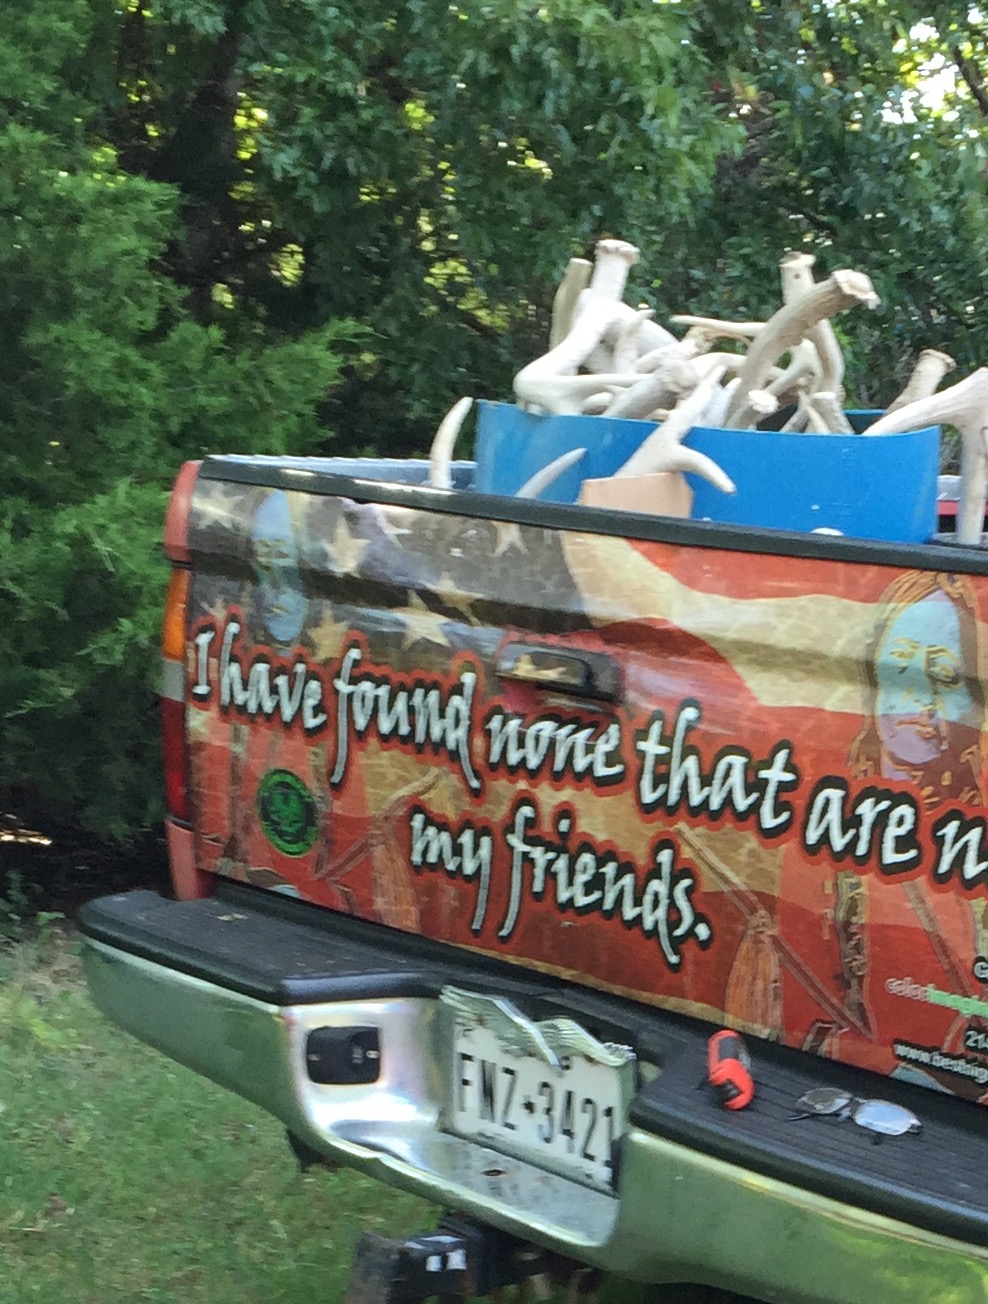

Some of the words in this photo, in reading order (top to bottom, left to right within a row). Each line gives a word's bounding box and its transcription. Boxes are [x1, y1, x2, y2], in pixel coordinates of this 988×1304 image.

[192, 630, 214, 696] I
[219, 621, 328, 730] have
[330, 648, 481, 790] found
[484, 712, 626, 778] none
[636, 705, 797, 830] that
[804, 786, 920, 867] are
[409, 811, 494, 933] my
[497, 804, 712, 965] friends.
